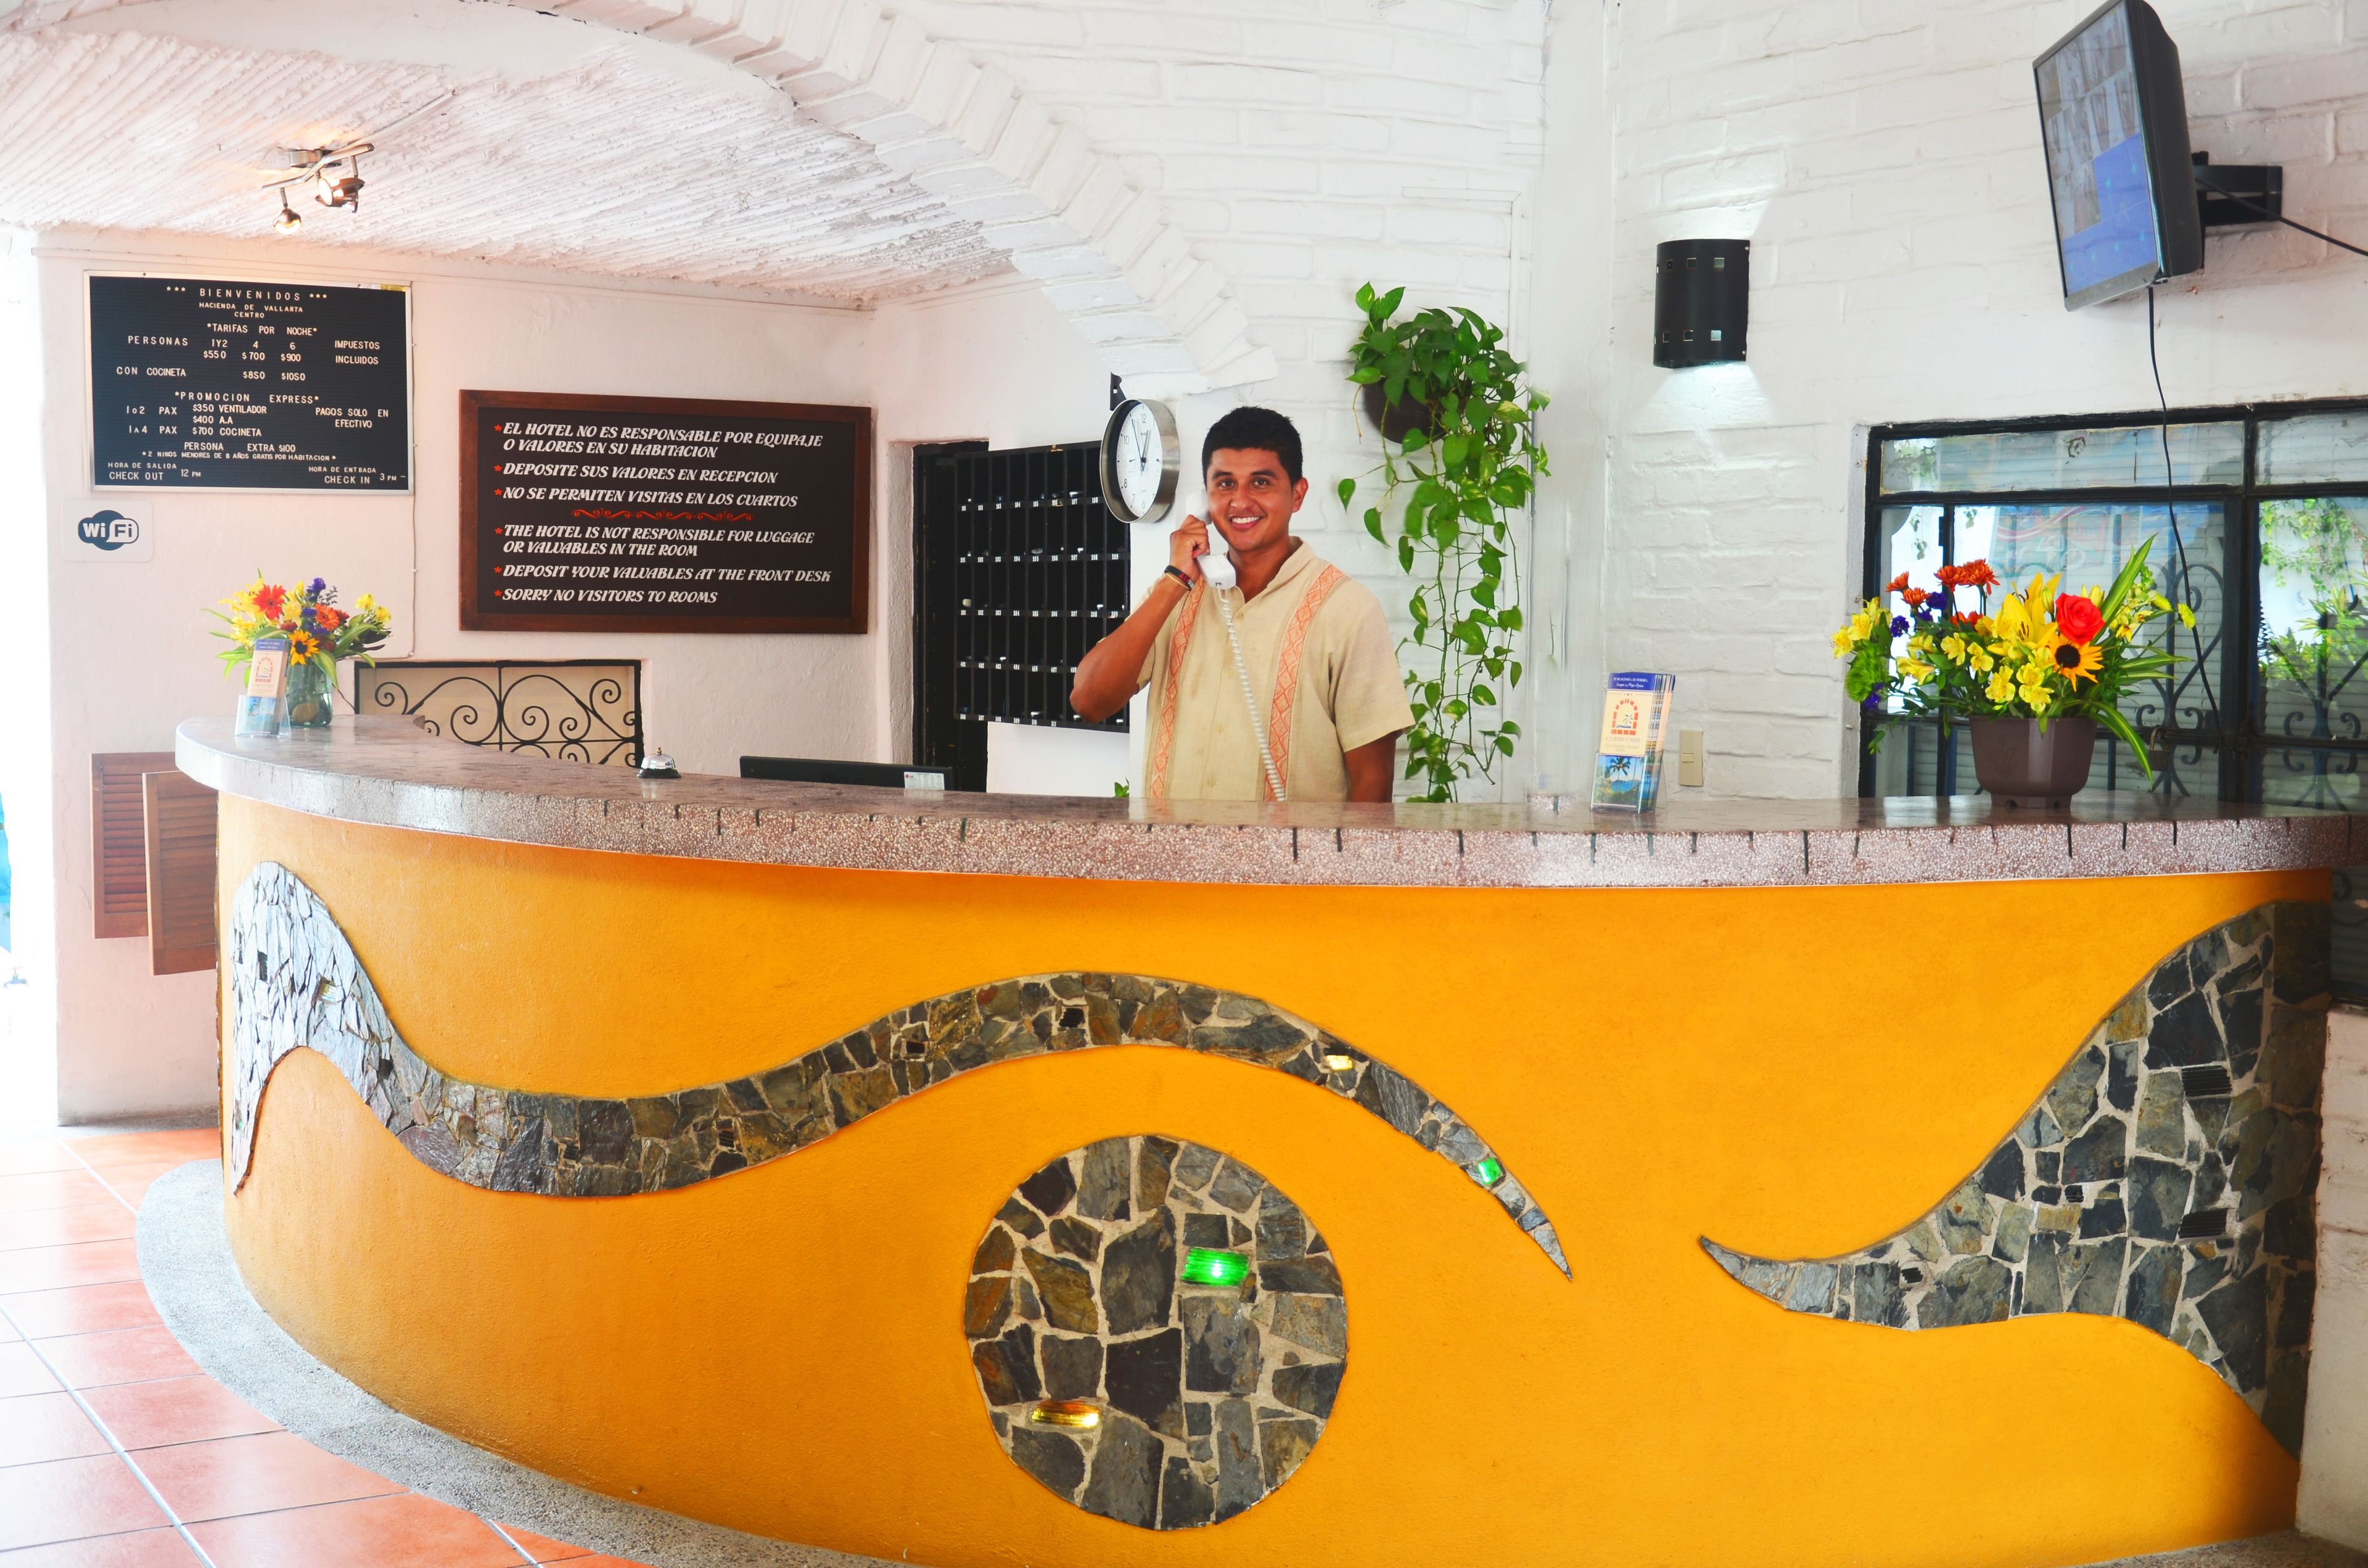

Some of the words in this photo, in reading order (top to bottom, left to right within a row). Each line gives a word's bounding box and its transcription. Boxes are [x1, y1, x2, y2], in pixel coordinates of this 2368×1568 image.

[200, 289, 299, 300] BIENVENIDOS
[259, 326, 274, 334] POR
[128, 335, 187, 346] PERSONAS
[335, 340, 379, 350] IMPUESTOS
[204, 350, 226, 359] $550
[281, 353, 301, 361] $900
[336, 356, 378, 364] INCLUIDOS
[147, 367, 186, 376] COCINETA
[193, 404, 214, 412] $350
[219, 404, 266, 413] VENTILADOR
[316, 408, 342, 416] PAGOS
[193, 416, 213, 424] $400
[335, 419, 372, 428] EFECTIVO
[1140, 414, 1146, 424] 12
[160, 426, 177, 434] PAX
[193, 427, 213, 435] $700
[220, 428, 261, 436] COCINETA
[503, 423, 522, 434] EL
[525, 424, 573, 436] HOTEL
[577, 426, 597, 437] NO
[599, 427, 618, 438] ES
[621, 427, 722, 442] RESPONSABLE
[724, 432, 753, 443] POR
[755, 433, 823, 448] EQUIPAJE
[1124, 435, 1129, 445] 10
[184, 442, 223, 450] PERSONA
[247, 443, 274, 451] EXTRA
[504, 439, 515, 450] O
[519, 440, 584, 453] VALORES
[586, 442, 607, 453] EN
[609, 443, 628, 454] SU
[631, 444, 718, 458] HABITACION
[109, 472, 139, 480] CHECK
[503, 463, 578, 476] DEPOSITE
[580, 466, 609, 477] SUS
[612, 467, 675, 480] VALORES
[678, 469, 697, 480] EN
[700, 470, 778, 483] RECEPCION
[1124, 478, 1128, 488] 8
[503, 487, 524, 498] NO
[527, 488, 546, 499] SE
[549, 488, 625, 501] PERMITEN
[628, 491, 683, 503] VISITAS
[686, 493, 705, 504] EN
[707, 493, 734, 504] LOS
[736, 495, 798, 507] CUARTOS
[1132, 493, 1135, 503] 7
[1141, 501, 1146, 509] 6
[505, 525, 533, 536] THE
[536, 526, 582, 538] HOTEL
[585, 527, 600, 538] IS
[602, 527, 631, 538] NOT
[632, 528, 725, 541] RESPONSIBLE
[728, 530, 754, 541] FOR
[756, 532, 815, 543] LUGGAGE
[504, 541, 524, 552] OR
[528, 542, 607, 554] VALUABLES
[610, 544, 626, 554] IN
[629, 544, 656, 555] THE
[659, 544, 697, 556] ROOM
[503, 565, 569, 577] DEPOSIT
[572, 567, 610, 578] YOUR
[614, 567, 693, 579] VALUABLES
[695, 569, 715, 580] AT
[718, 569, 746, 580] THE
[748, 570, 794, 581] FRONT
[796, 571, 831, 581] DESK
[503, 589, 553, 601] SORRY
[554, 589, 574, 601] NO
[578, 590, 644, 602] VISITORS
[648, 591, 665, 602] TO
[668, 591, 718, 602] ROOMS
